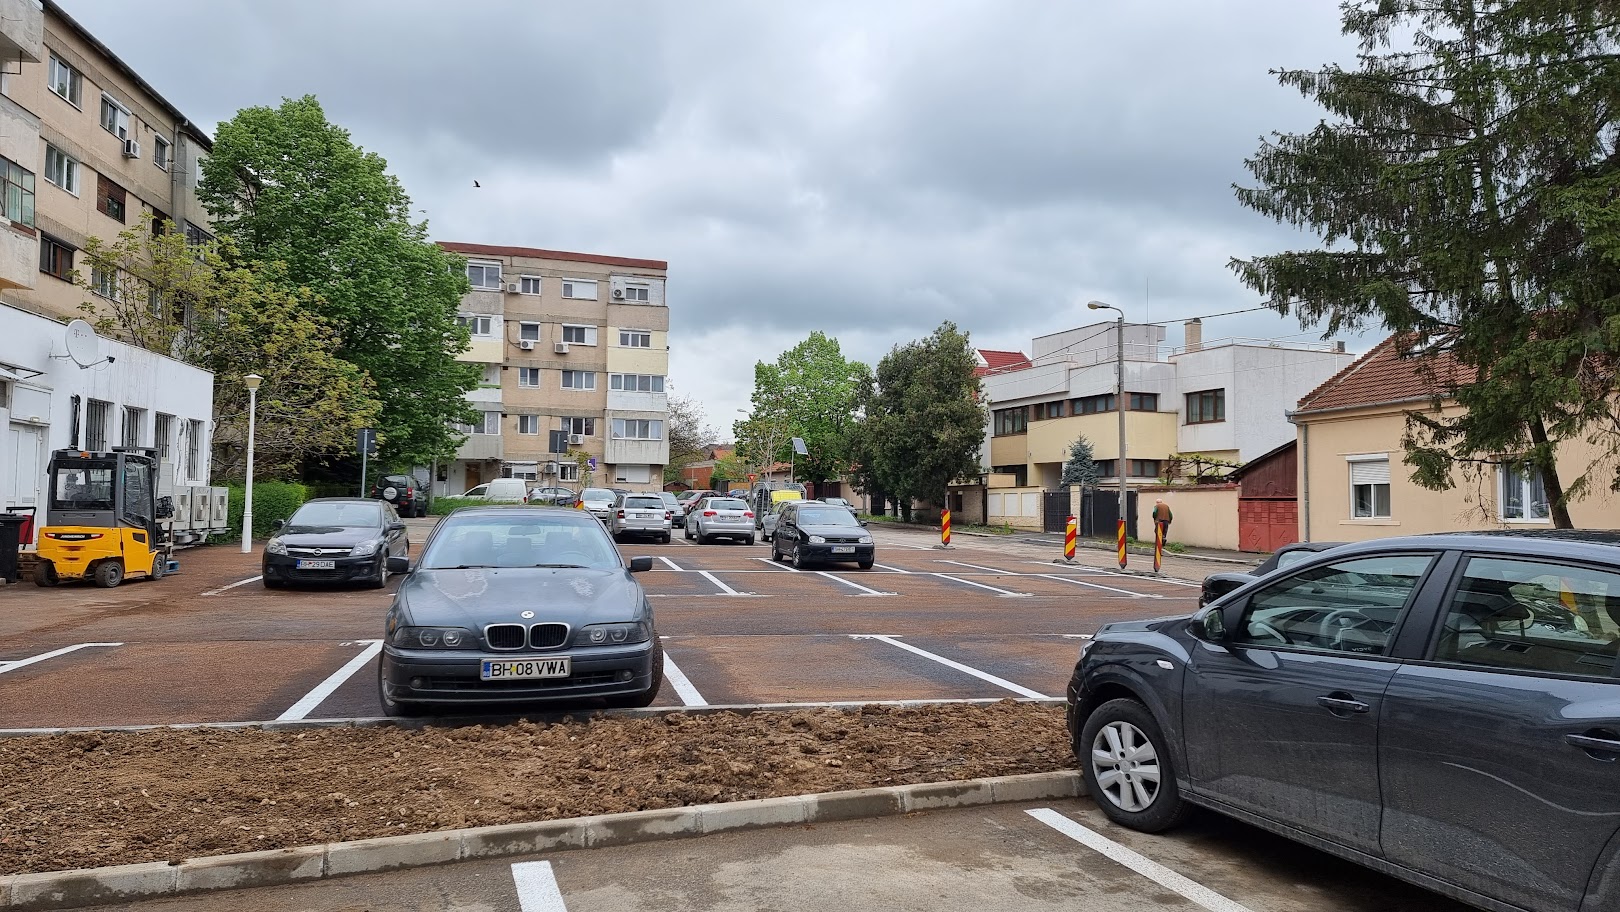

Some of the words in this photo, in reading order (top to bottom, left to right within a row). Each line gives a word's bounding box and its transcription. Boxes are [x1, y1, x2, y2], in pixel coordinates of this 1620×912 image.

[491, 663, 513, 677] BH
[516, 662, 533, 676] 08
[536, 661, 566, 675] VWA
